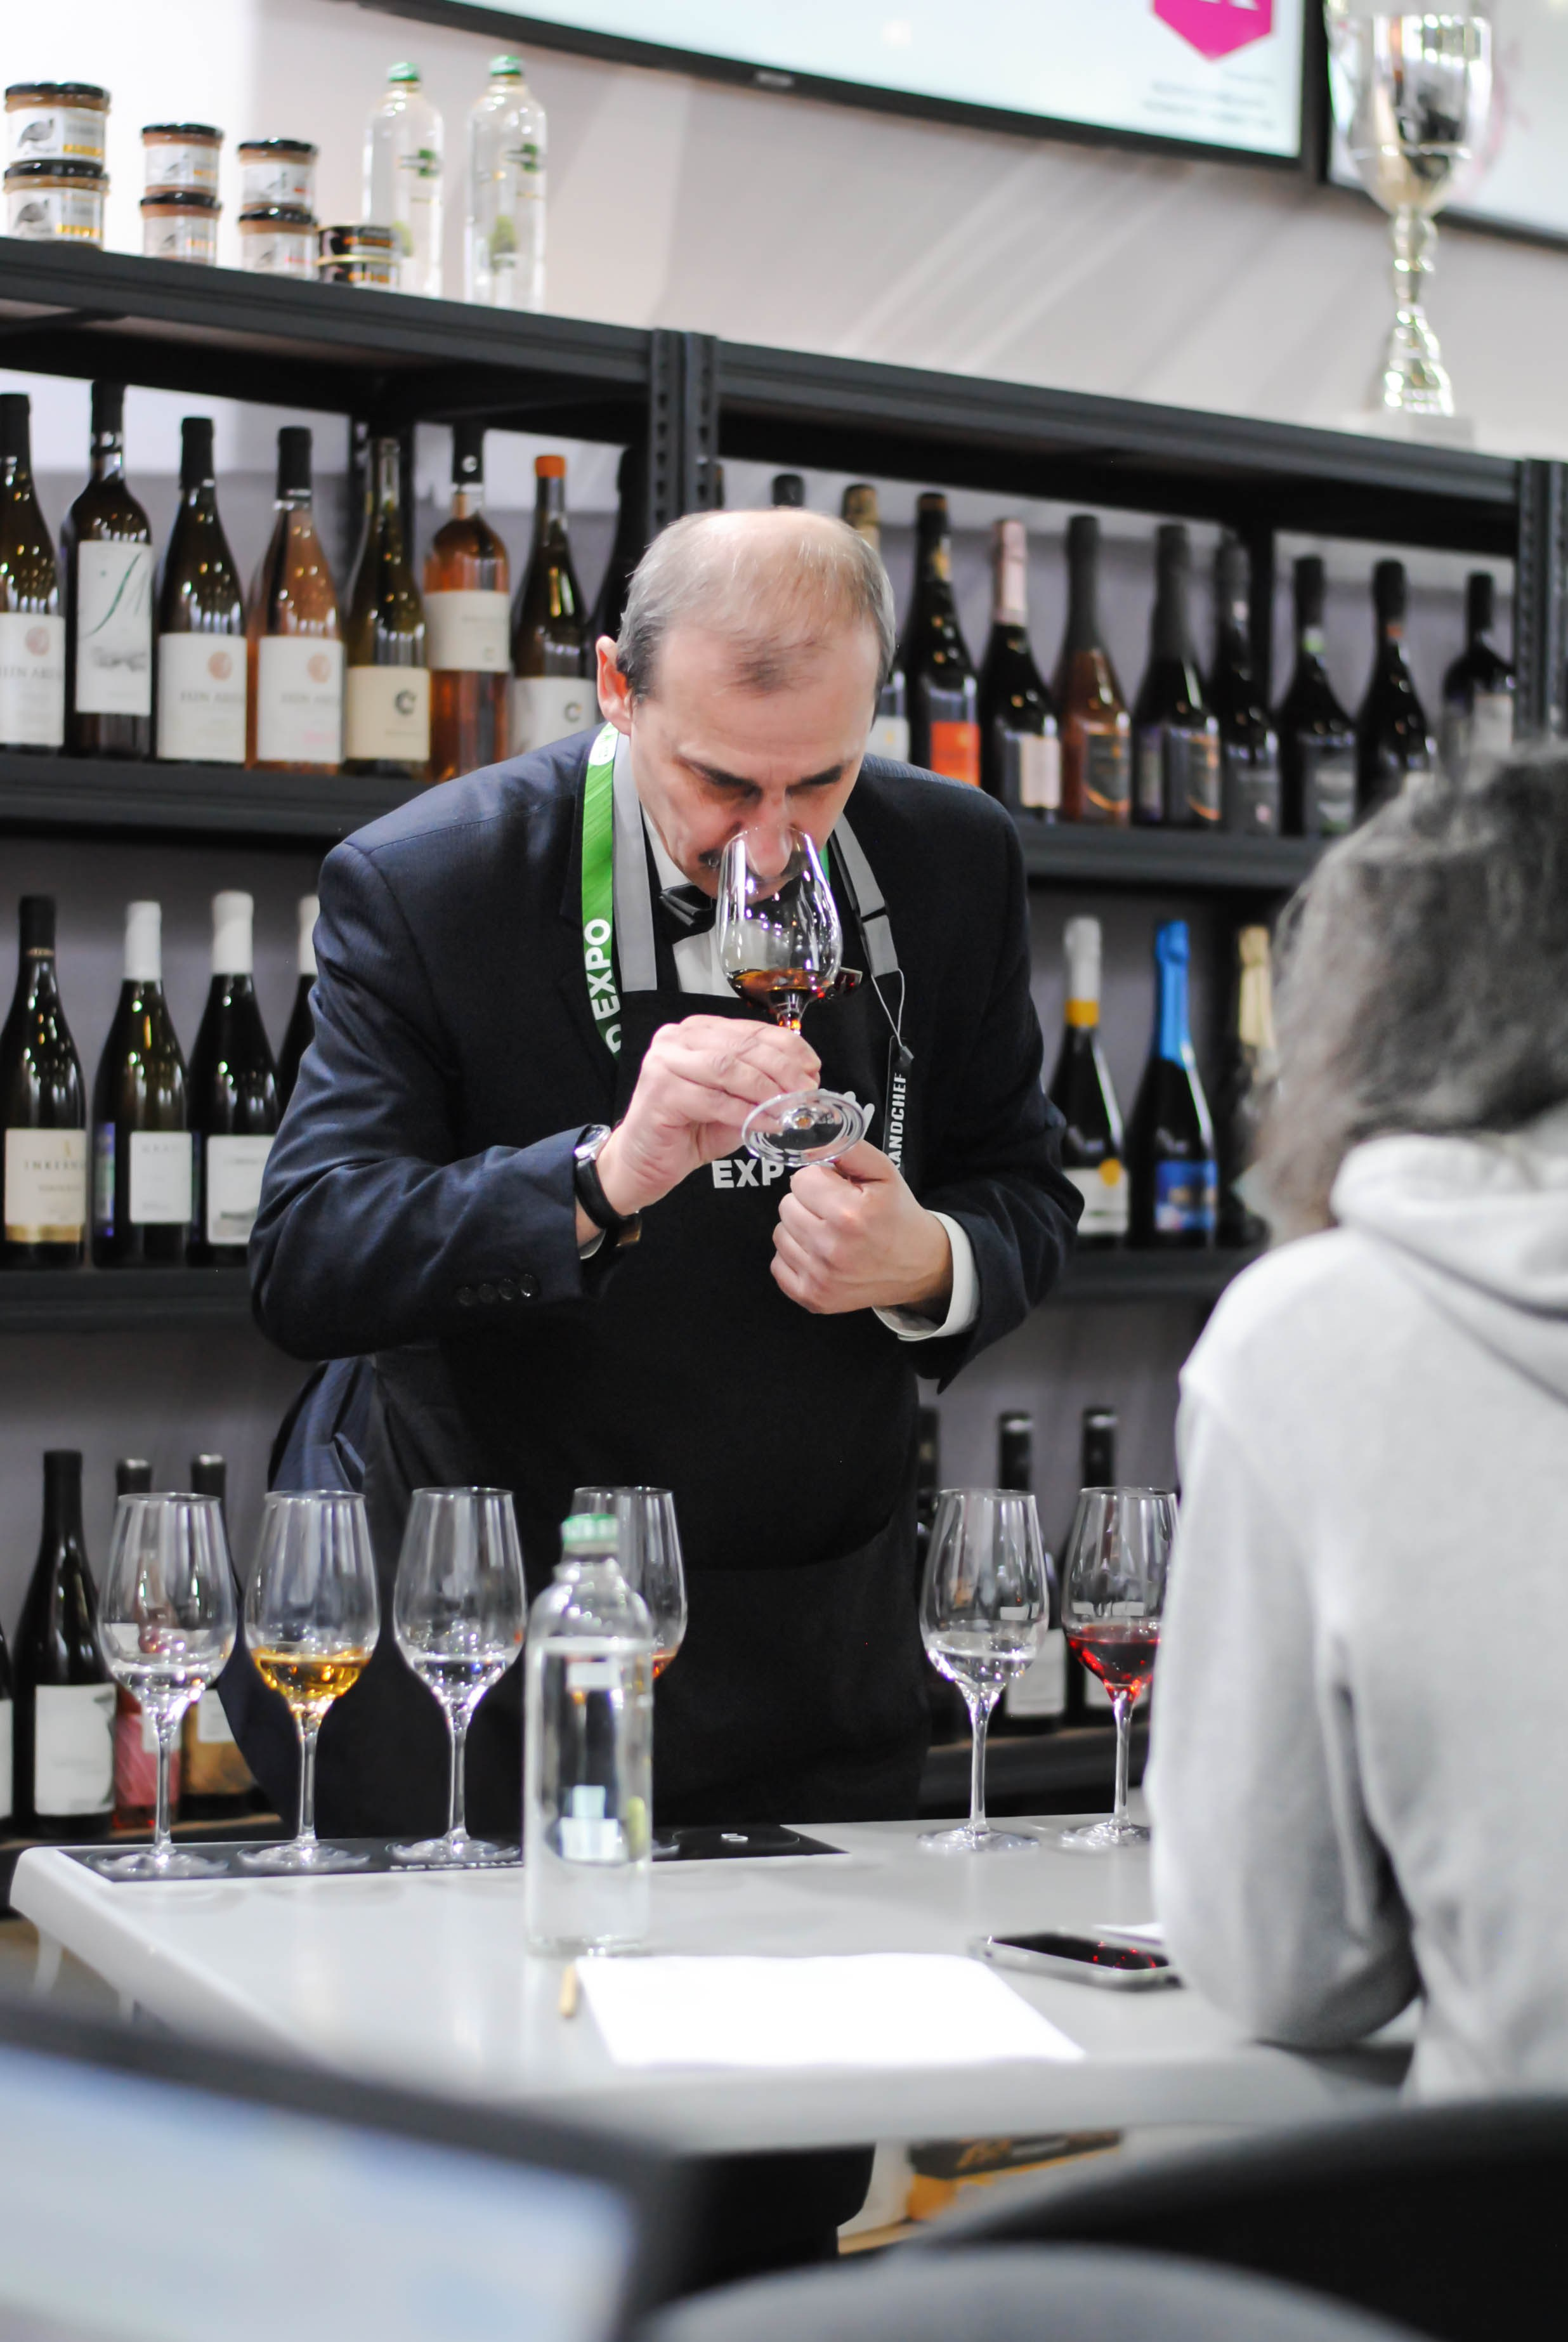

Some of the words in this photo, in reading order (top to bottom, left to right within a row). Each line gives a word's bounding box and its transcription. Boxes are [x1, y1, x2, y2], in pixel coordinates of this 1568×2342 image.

[584, 919, 621, 1021] EXPO
[887, 1072, 906, 1171] ANDCHEF
[712, 1158, 785, 1189] EXP
